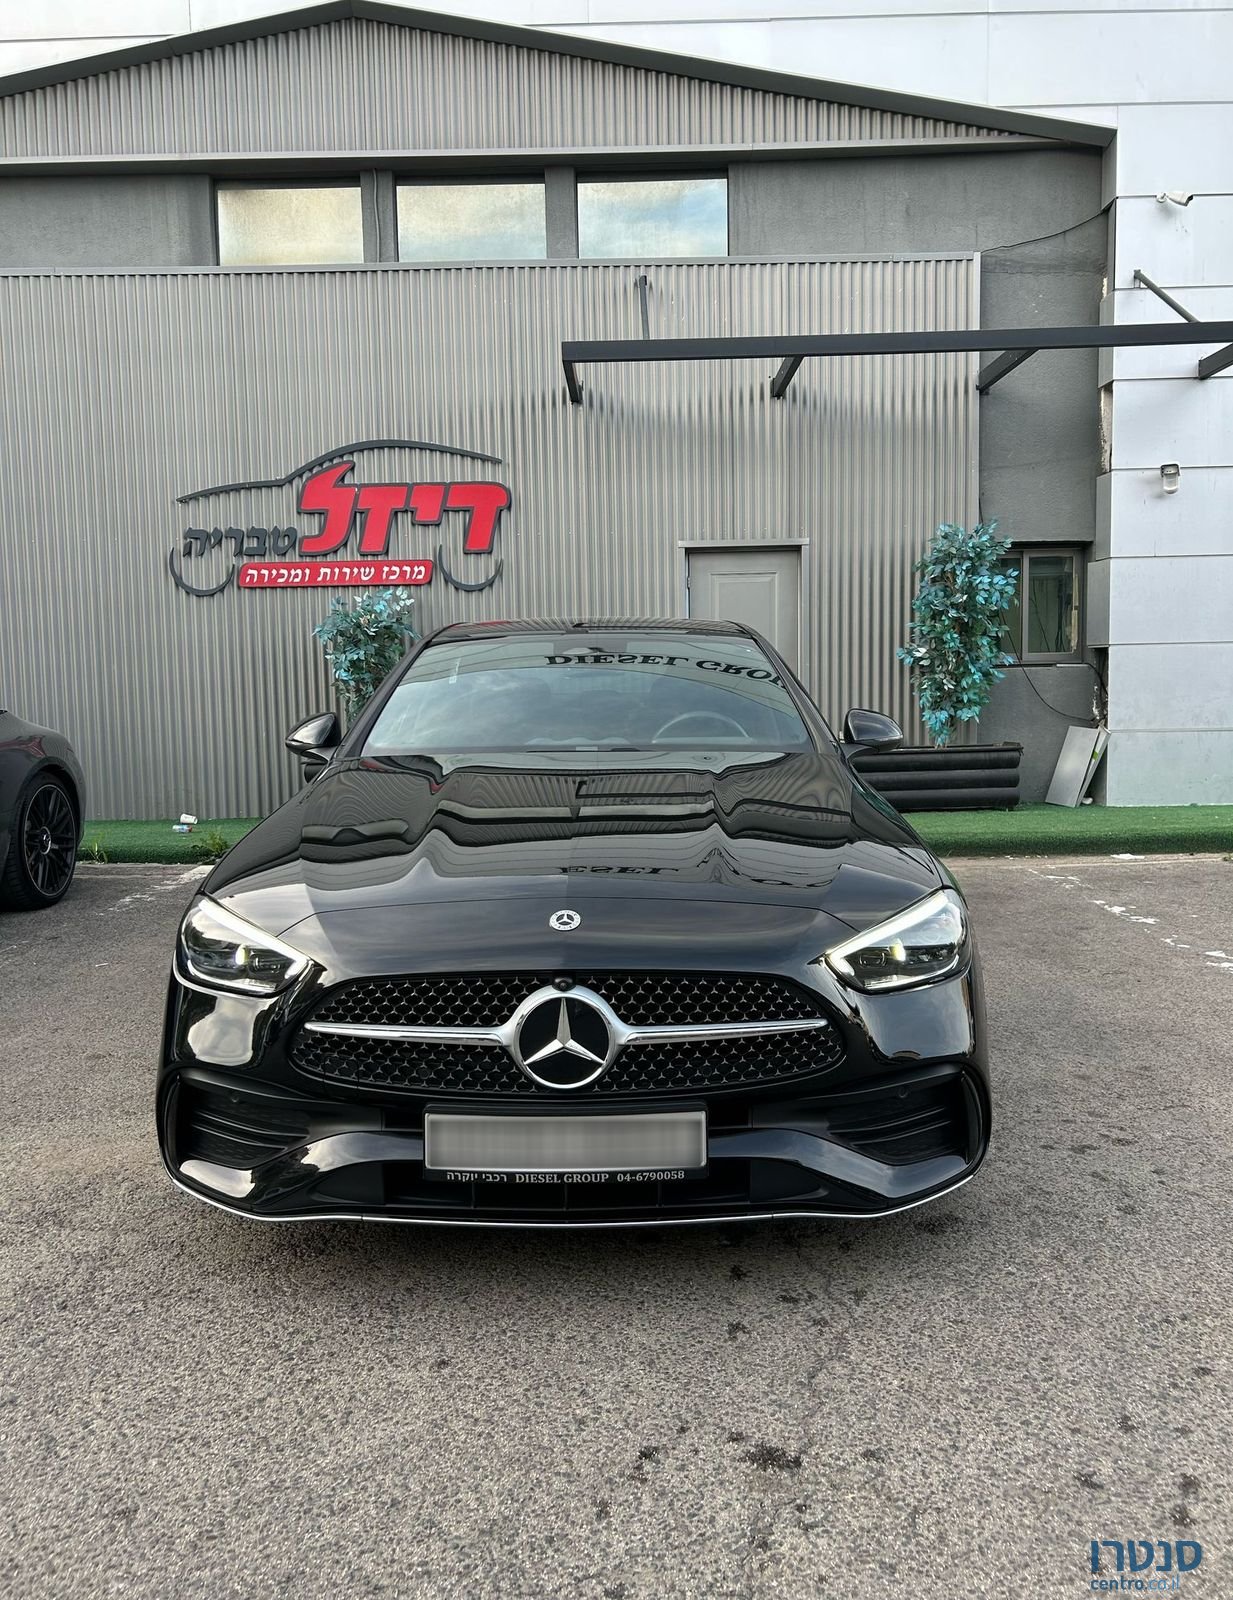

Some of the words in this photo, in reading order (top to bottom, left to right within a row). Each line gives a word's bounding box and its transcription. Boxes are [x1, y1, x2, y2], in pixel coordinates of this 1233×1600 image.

[297, 459, 511, 556] דיזל
[182, 525, 297, 557] טבריה
[245, 567, 310, 583] ומכירה
[317, 566, 375, 582] שירות
[382, 564, 426, 580] מרכז
[446, 1172, 478, 1182] יוקרה
[482, 1173, 507, 1182] רכבי
[515, 1173, 561, 1183] DIESEL
[563, 1173, 609, 1183] GROUP
[616, 1170, 685, 1182] 04-6790058
